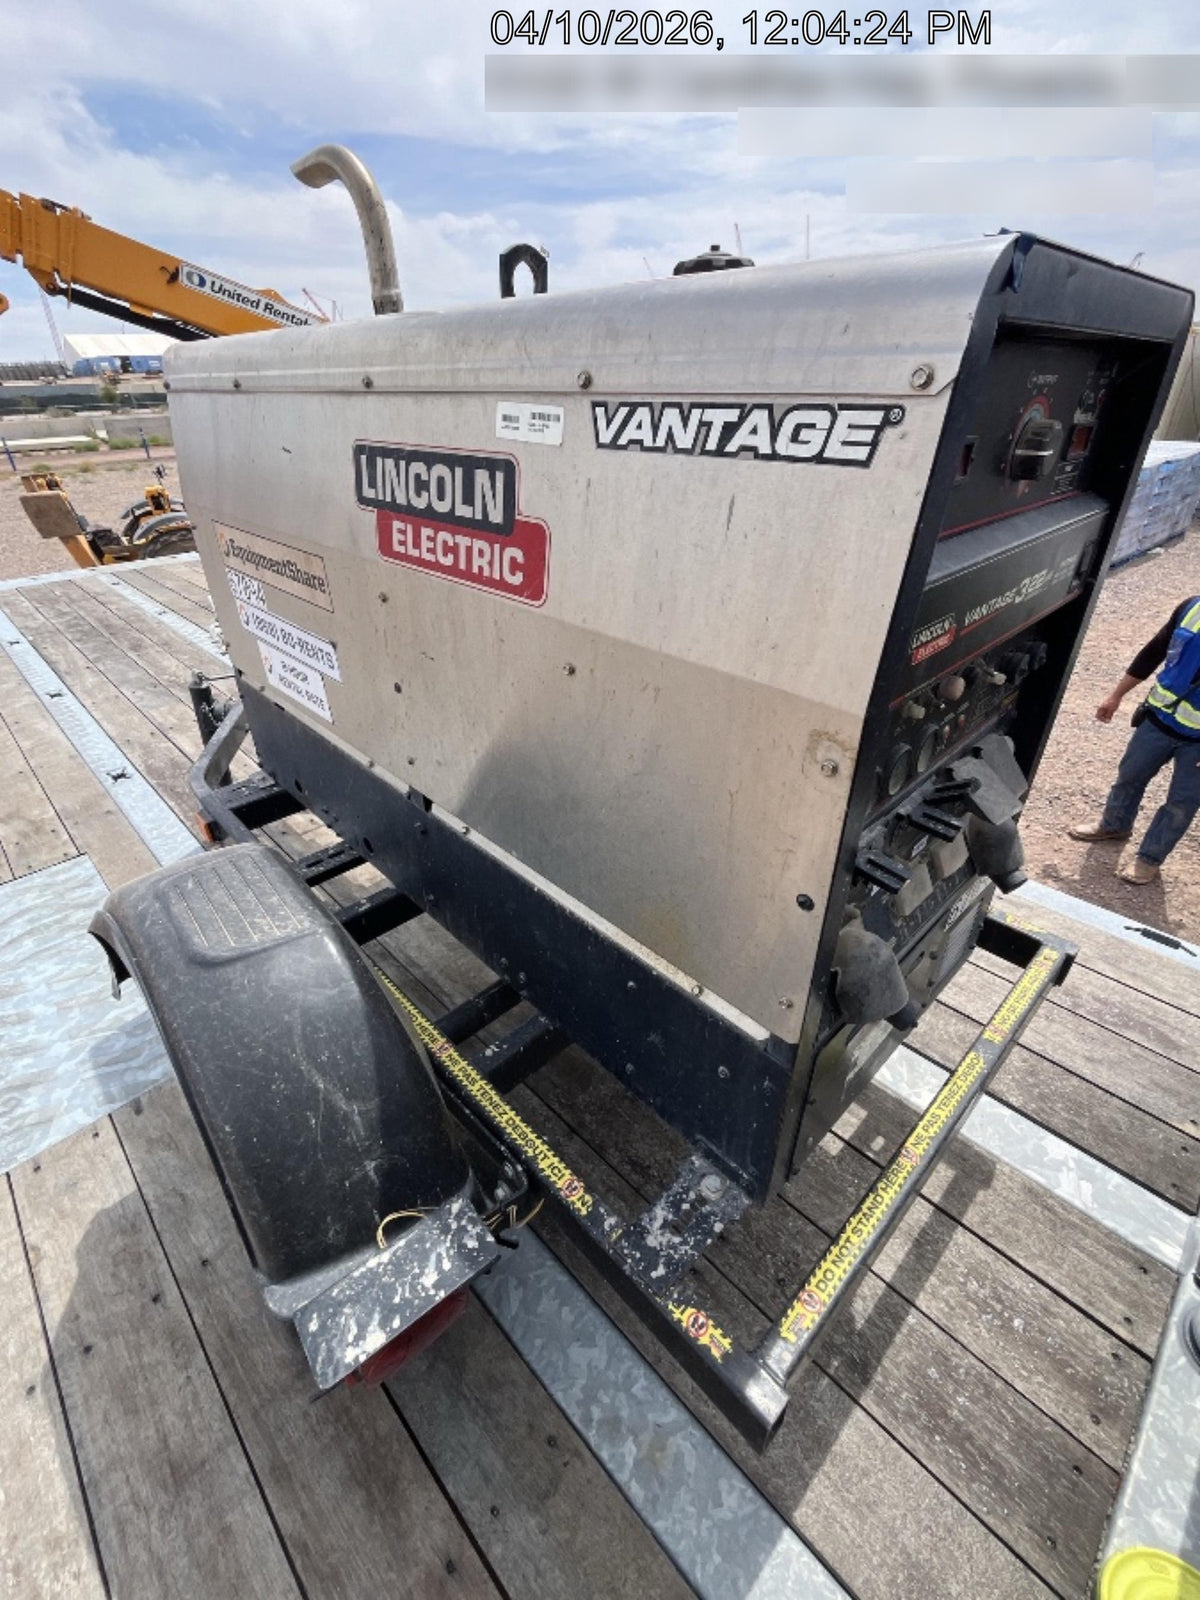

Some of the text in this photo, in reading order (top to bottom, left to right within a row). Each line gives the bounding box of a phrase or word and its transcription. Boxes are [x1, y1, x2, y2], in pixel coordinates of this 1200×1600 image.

[210, 280, 312, 326] United Rental
[360, 454, 504, 524] LINCOLN
[392, 520, 525, 586] ELECTRIC
[458, 1065, 478, 1087] PAS
[475, 1084, 510, 1119] TENEZ
[505, 1117, 551, 1162] DEBOUT
[549, 1162, 566, 1181] ICI
[910, 1132, 924, 1149] NE
[922, 1113, 942, 1132] PAS
[935, 1080, 961, 1112] TENEZ
[815, 1160, 907, 1293] DO NOT STAND HERE
